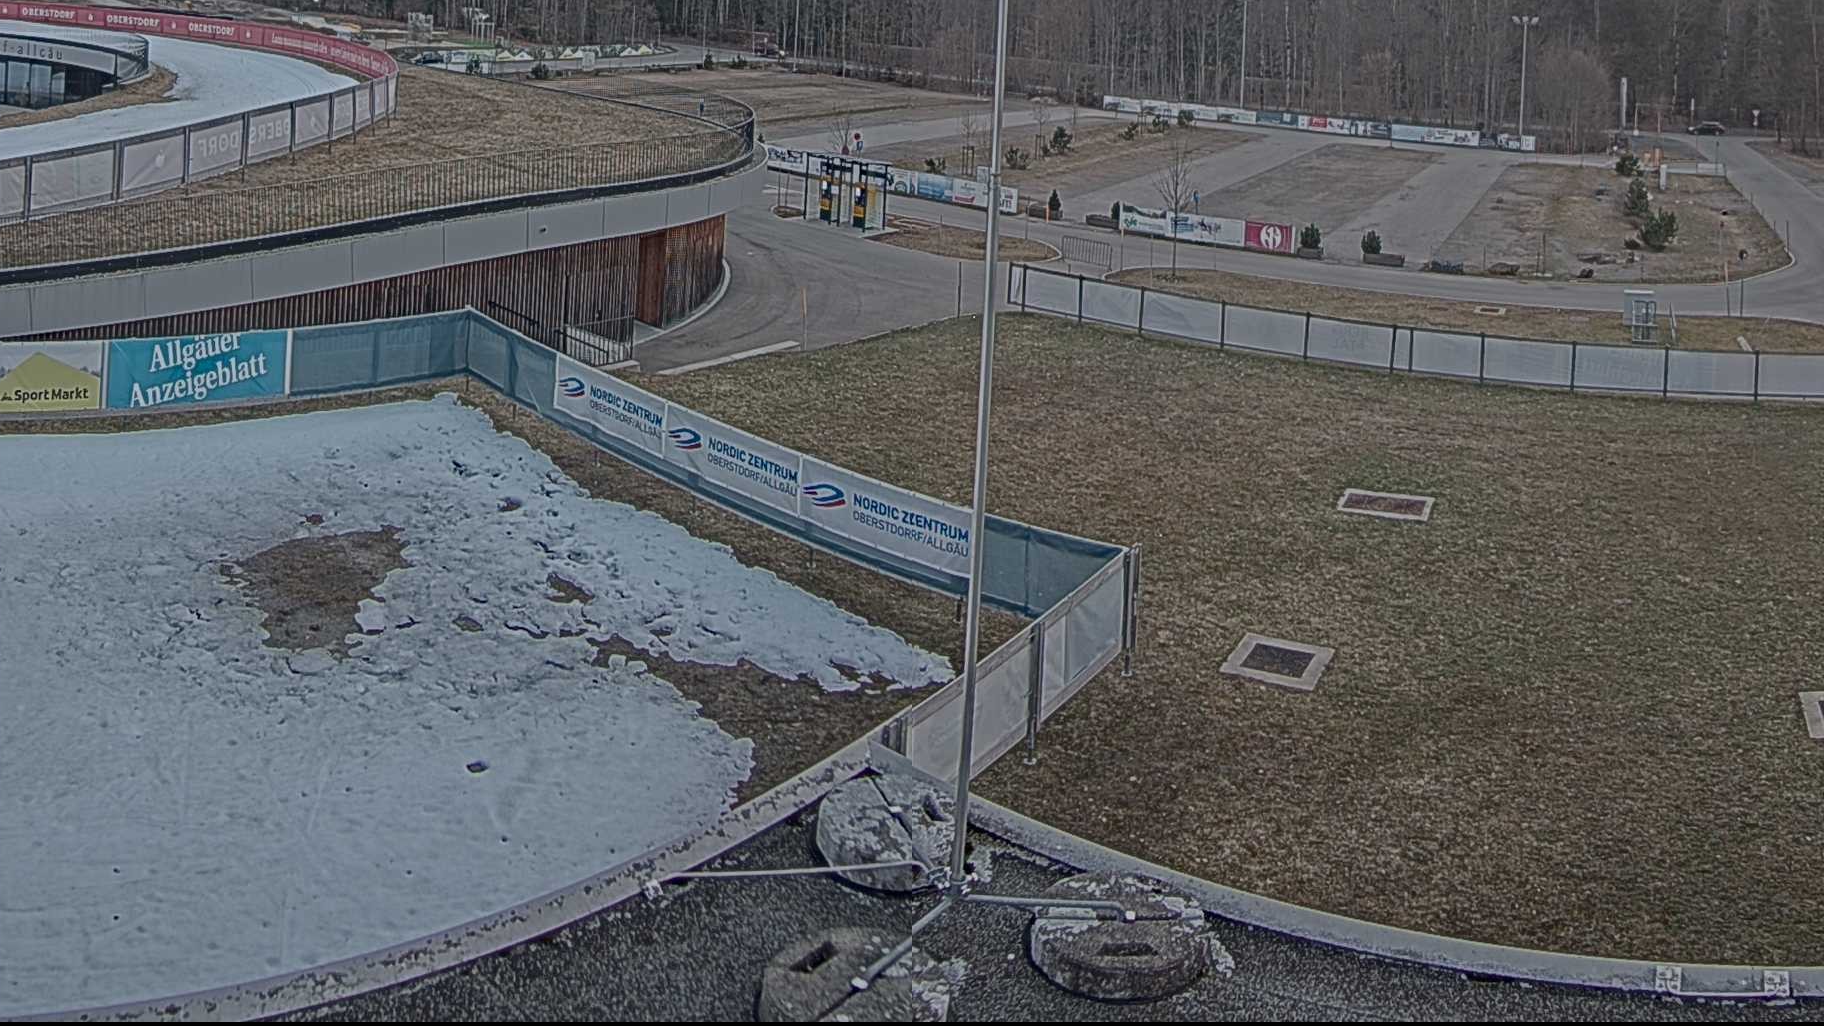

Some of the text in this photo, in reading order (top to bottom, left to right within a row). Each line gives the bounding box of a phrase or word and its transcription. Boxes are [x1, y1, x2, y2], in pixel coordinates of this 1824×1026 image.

[22, 7, 76, 20] OBERSTDORF
[106, 15, 161, 28] OBERSTDORF
[188, 23, 235, 36] OBERSTDORF
[149, 334, 241, 372] Allgäuer
[14, 389, 49, 403] Sport
[51, 387, 89, 400] Markt
[130, 353, 267, 408] Anzeigeblatt
[590, 384, 663, 427] NORDIC ZENTRUM
[707, 452, 797, 497] OBERSTDORF/ALLGÄU
[708, 437, 798, 484] NORDIC ZENTRUM
[853, 493, 899, 520] NORDIC
